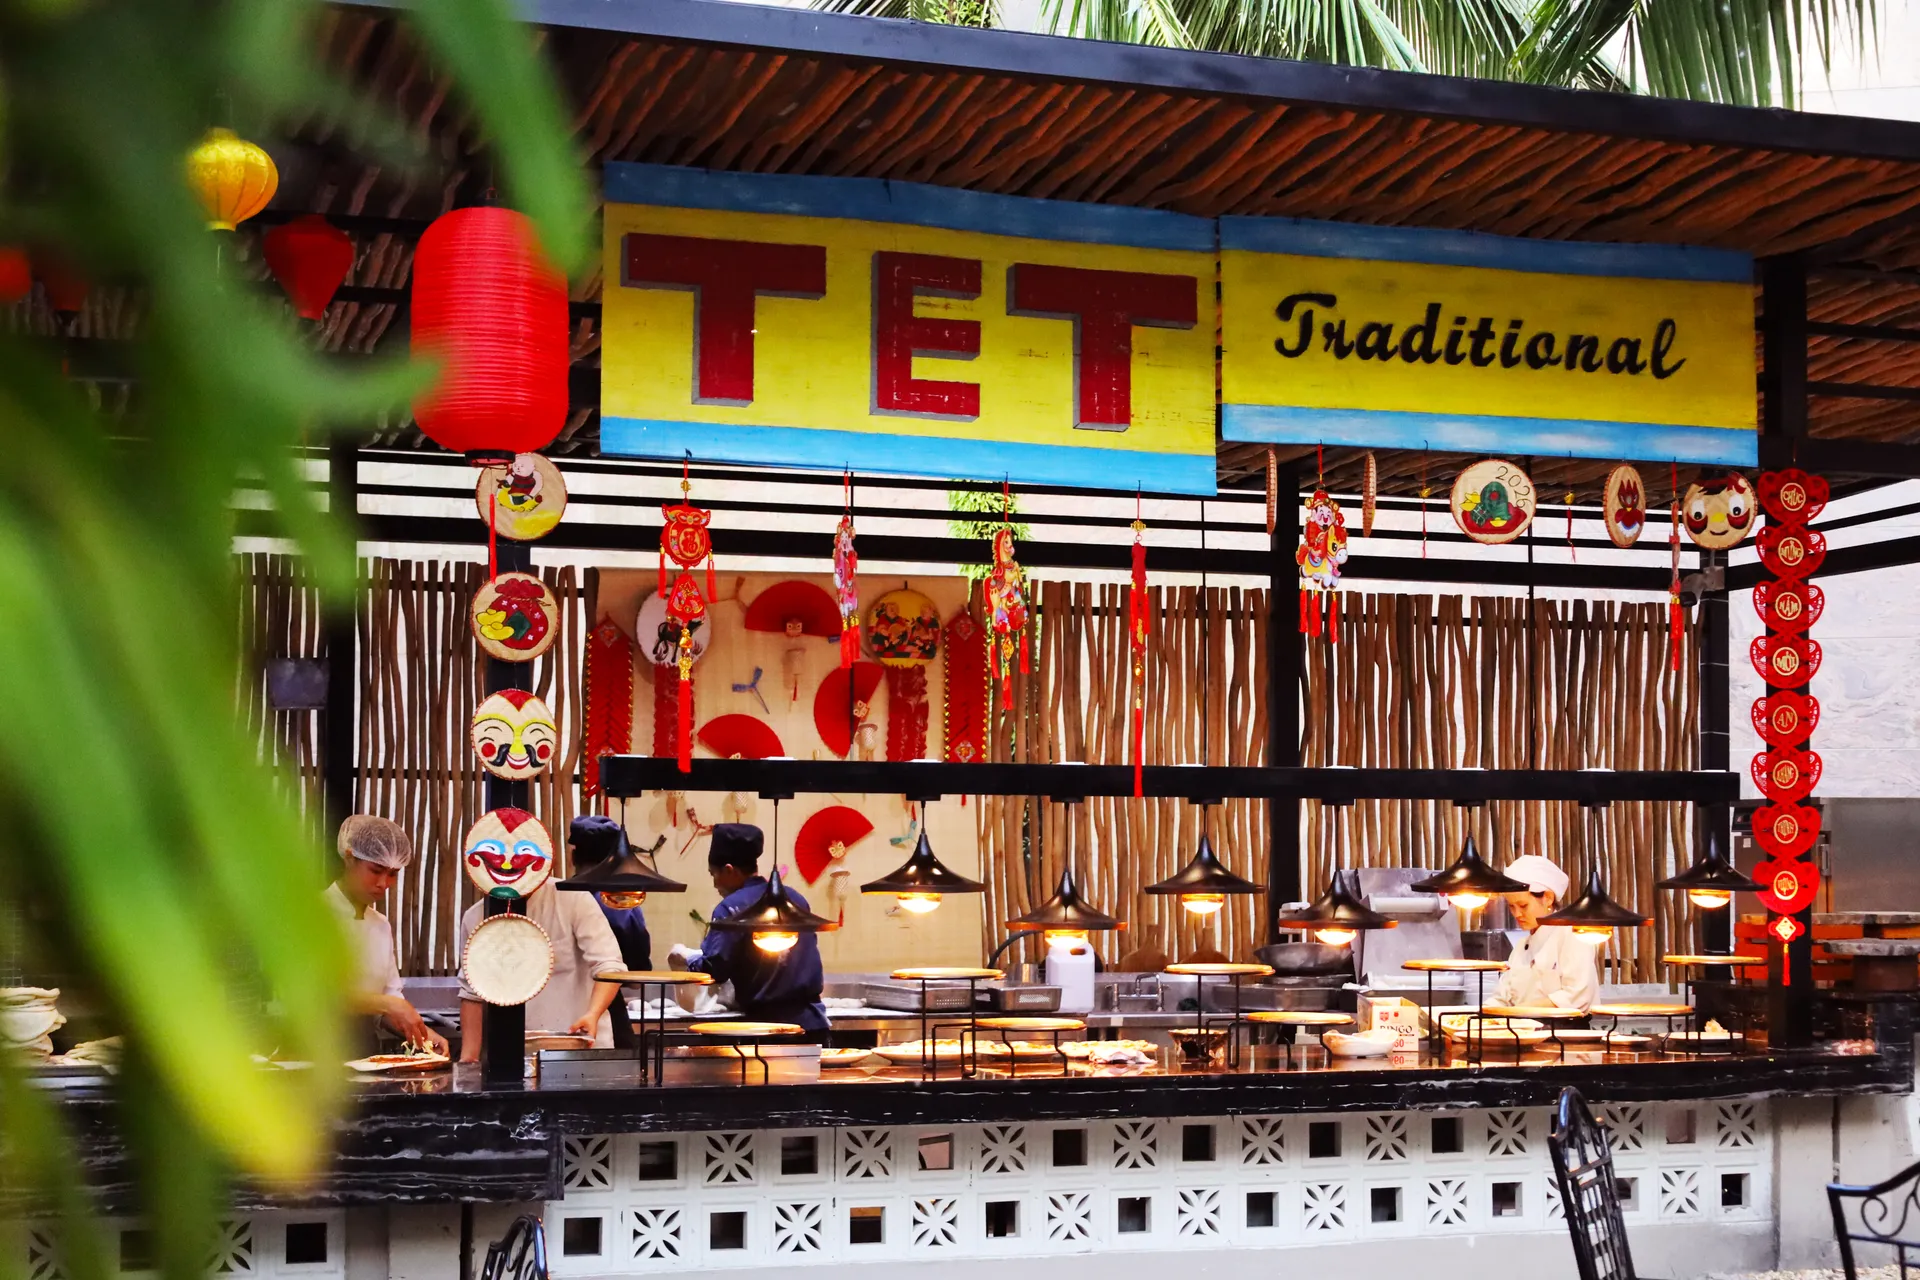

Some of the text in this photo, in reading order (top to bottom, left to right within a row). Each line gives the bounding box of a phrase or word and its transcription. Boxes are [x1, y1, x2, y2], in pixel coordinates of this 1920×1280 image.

[620, 232, 1198, 433] TET
[1274, 292, 1687, 380] Traditional
[1495, 465, 1532, 508] 2026
[1777, 711, 1795, 728] AN
